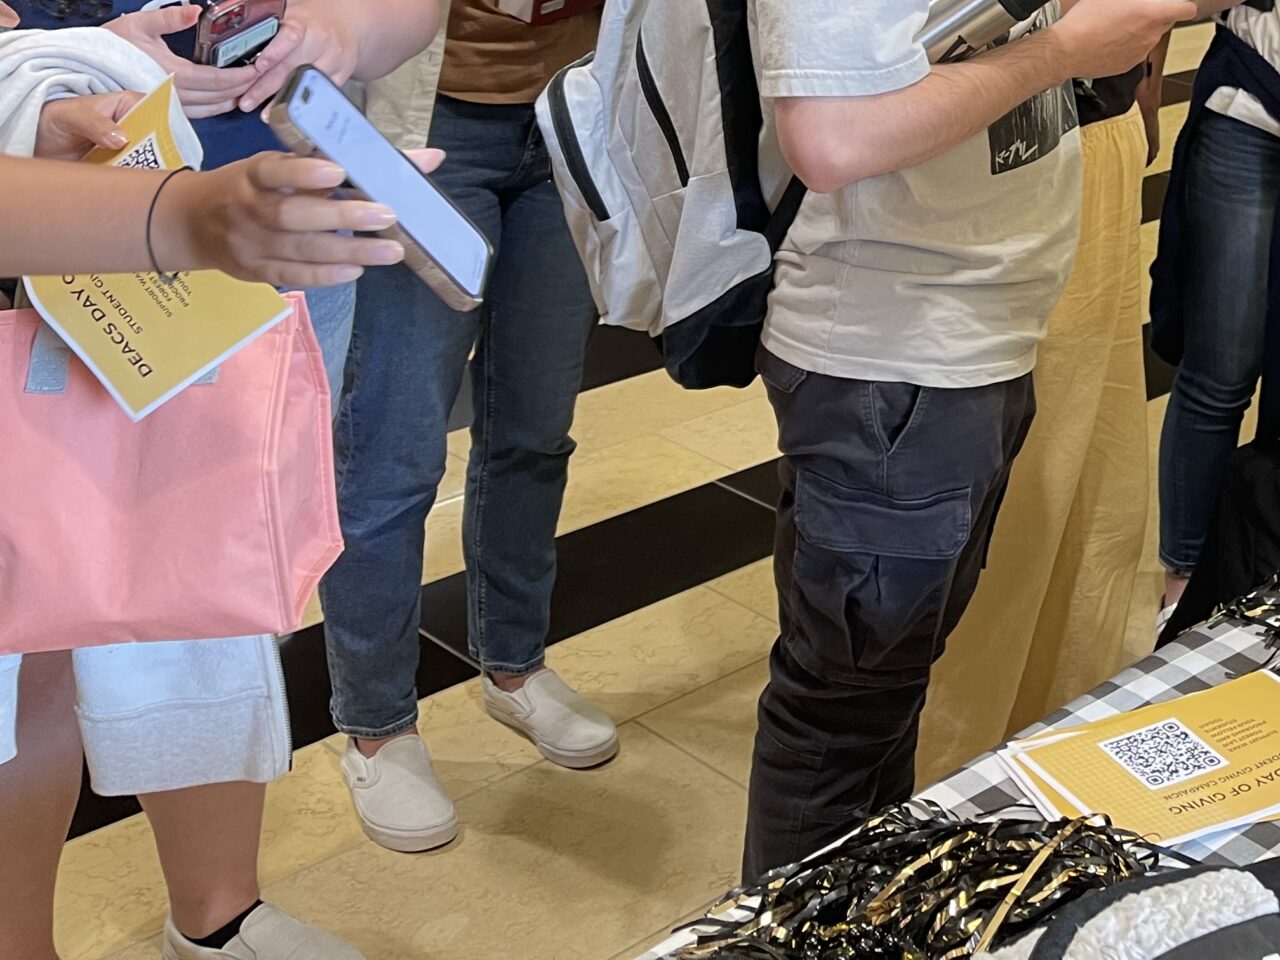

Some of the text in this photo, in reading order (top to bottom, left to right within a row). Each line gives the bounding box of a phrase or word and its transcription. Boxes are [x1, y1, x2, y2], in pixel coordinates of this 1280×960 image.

[133, 272, 173, 318] SUPPORT WA
[101, 289, 143, 335] STUDENT
[62, 274, 154, 378] DEACS DAY O
[1219, 766, 1253, 784] GIVING
[1163, 778, 1218, 801] CAMPAIGN
[1229, 782, 1252, 797] OF
[1168, 792, 1226, 815] GIVING
